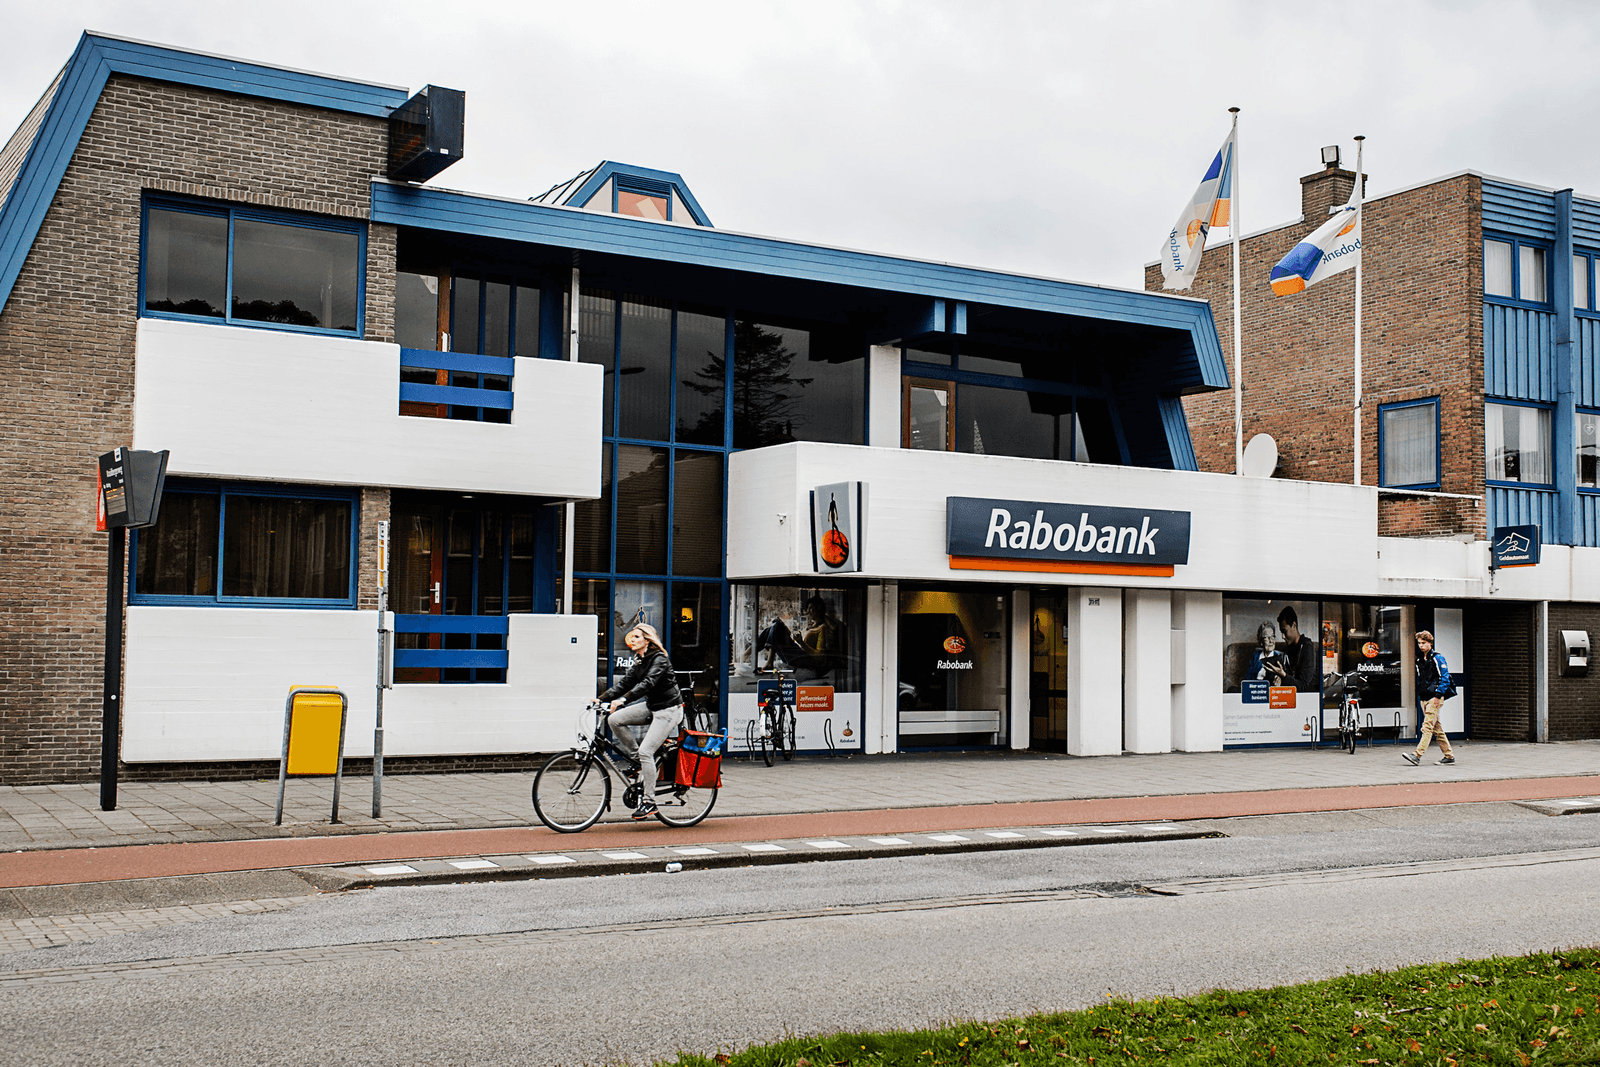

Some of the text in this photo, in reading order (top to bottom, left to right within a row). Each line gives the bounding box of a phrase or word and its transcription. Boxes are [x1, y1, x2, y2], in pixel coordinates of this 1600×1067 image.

[984, 508, 1160, 555] Rabobank
[937, 660, 974, 669] Rabobank
[1357, 663, 1385, 672] Rabobank
